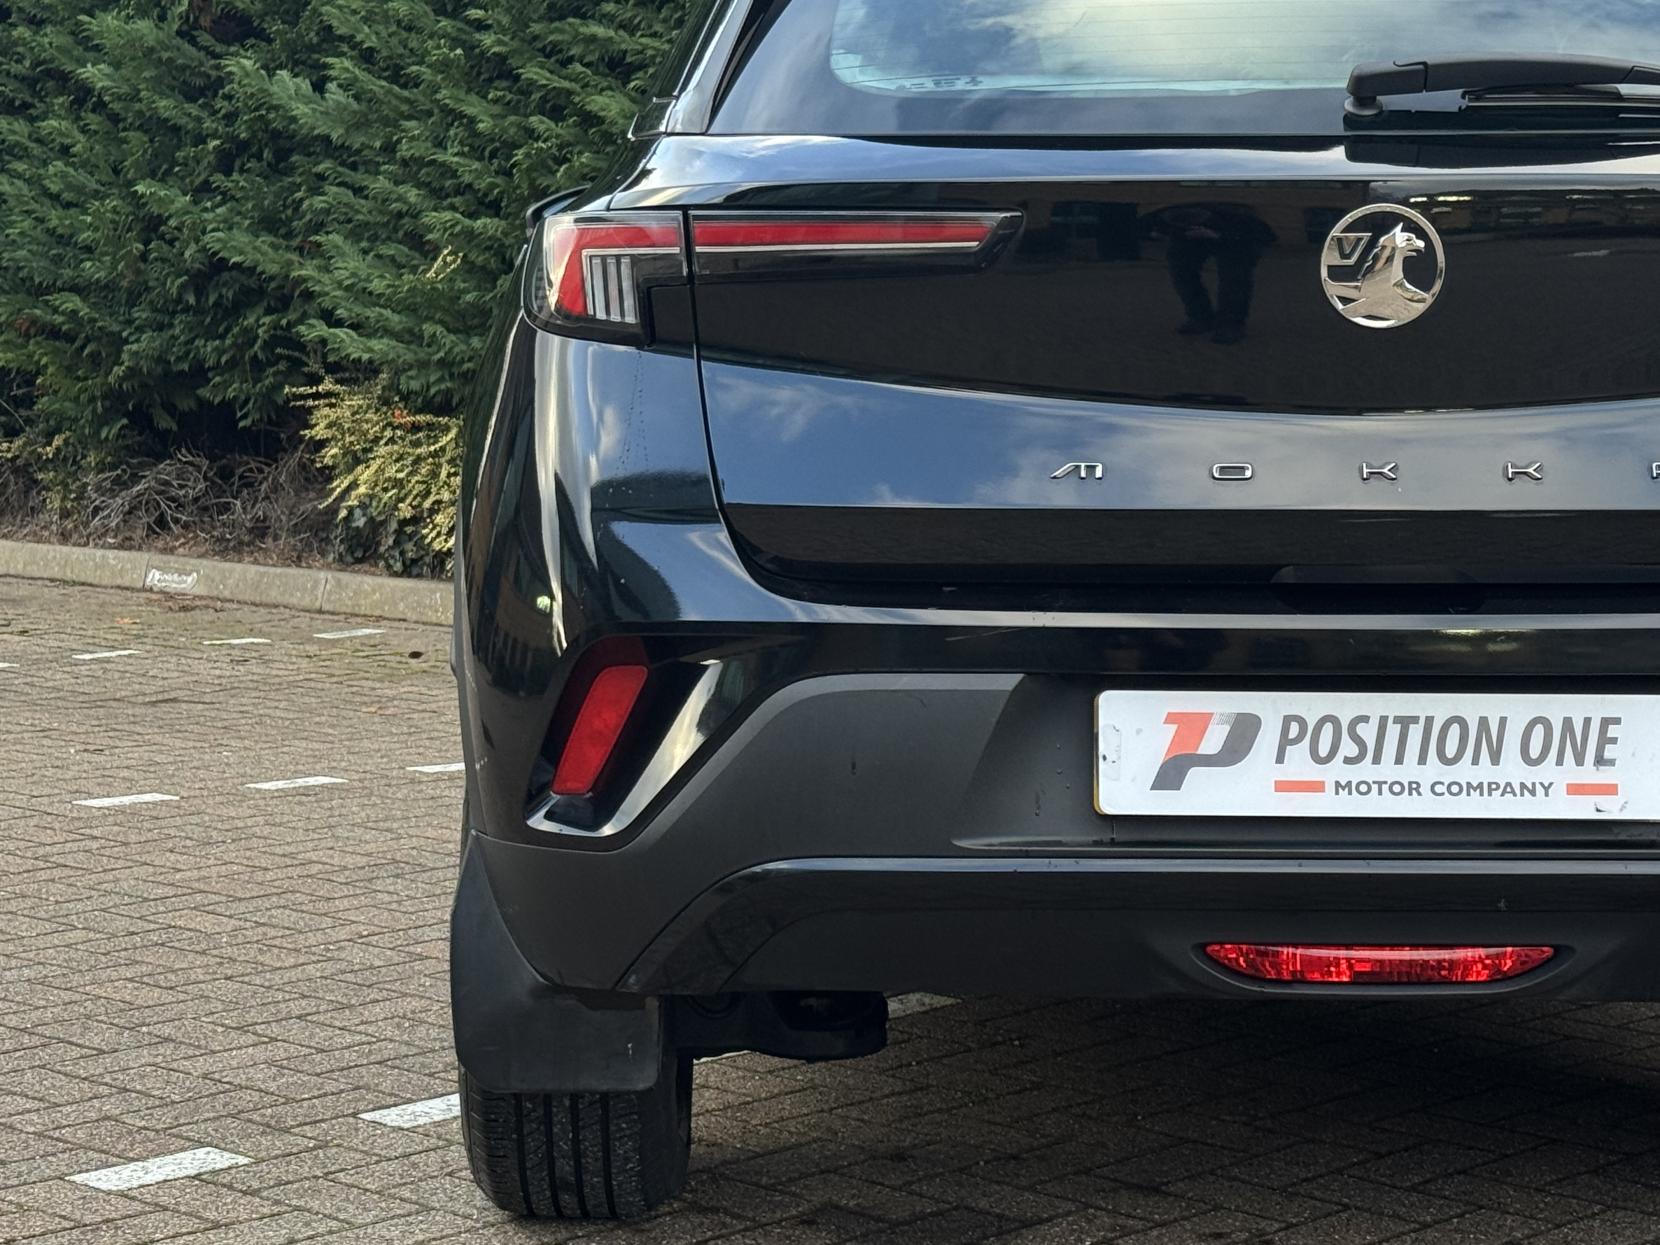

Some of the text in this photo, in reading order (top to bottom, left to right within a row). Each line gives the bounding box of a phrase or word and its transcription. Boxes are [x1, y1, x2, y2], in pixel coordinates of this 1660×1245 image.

[1050, 461, 1660, 480] MOKK
[1274, 714, 1622, 767] POSITION ONE
[1334, 780, 1555, 798] MOTOR COMPANY
